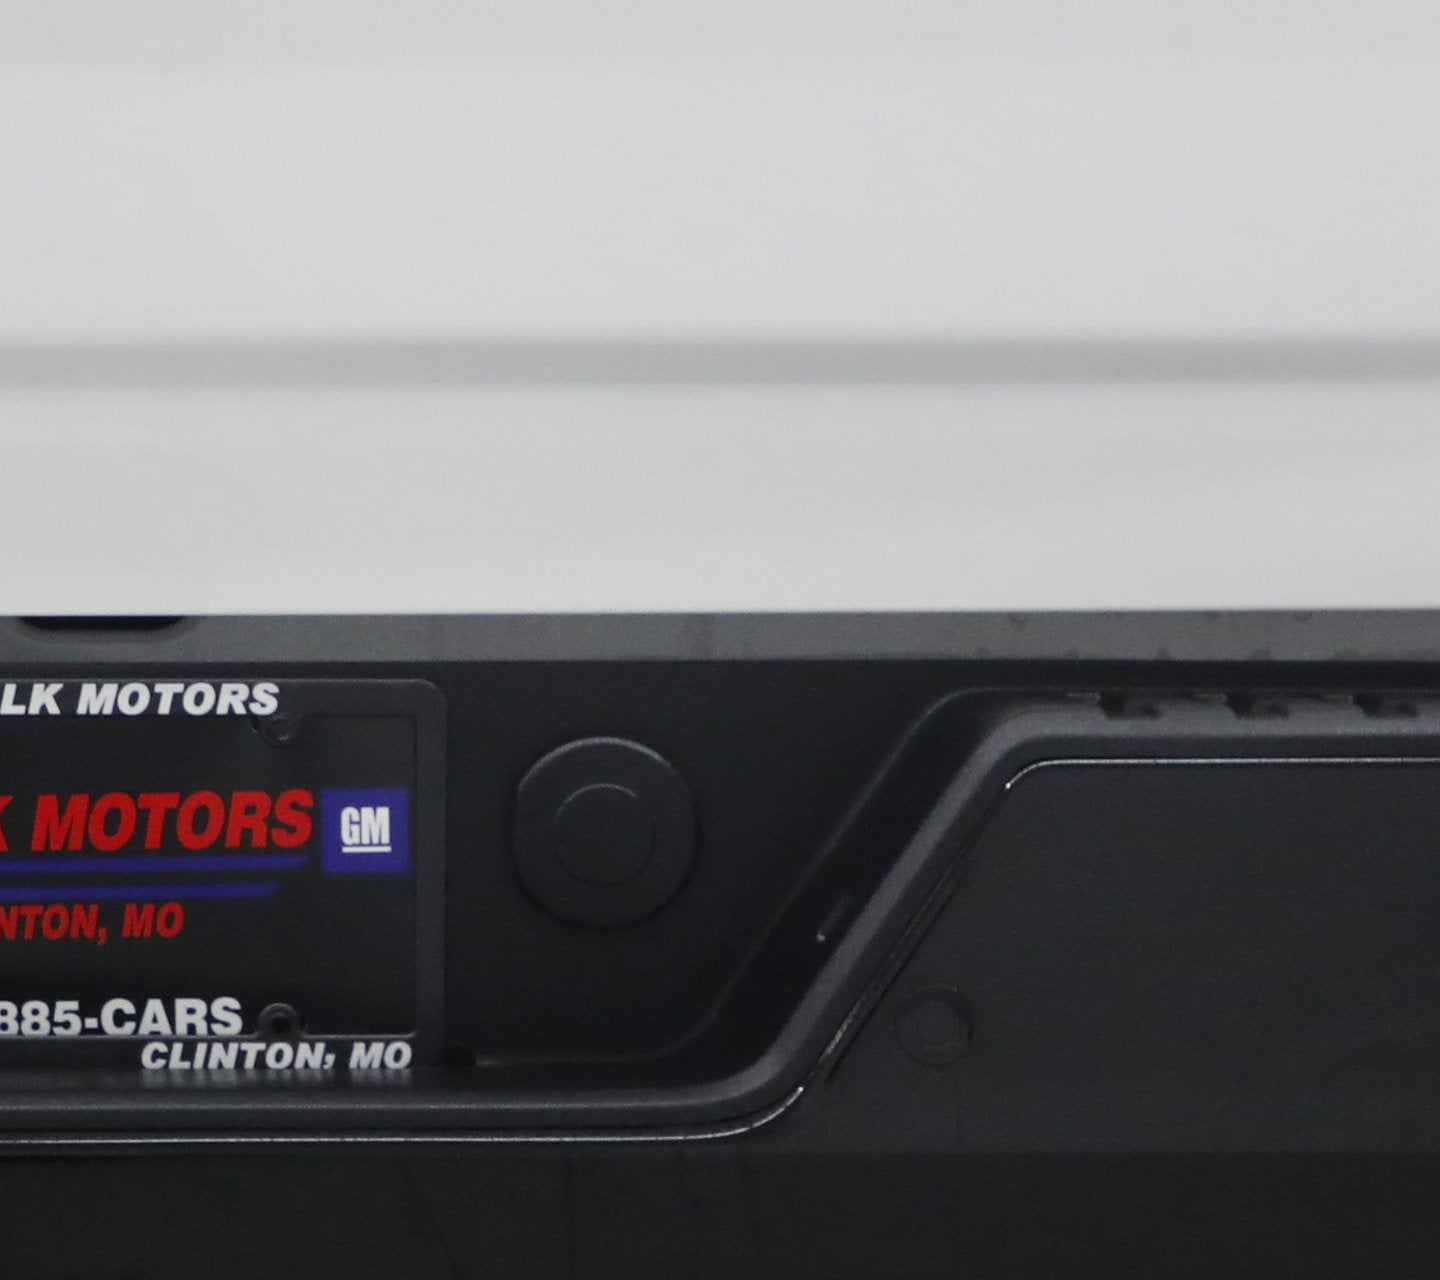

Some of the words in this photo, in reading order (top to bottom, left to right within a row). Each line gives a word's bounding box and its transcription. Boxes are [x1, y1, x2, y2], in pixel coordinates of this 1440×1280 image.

[76, 681, 281, 717] MOTORS
[29, 787, 317, 853] MOTORS
[120, 901, 186, 939] MO
[140, 1041, 336, 1072] CLINTON,
[348, 1041, 413, 1071] MO
